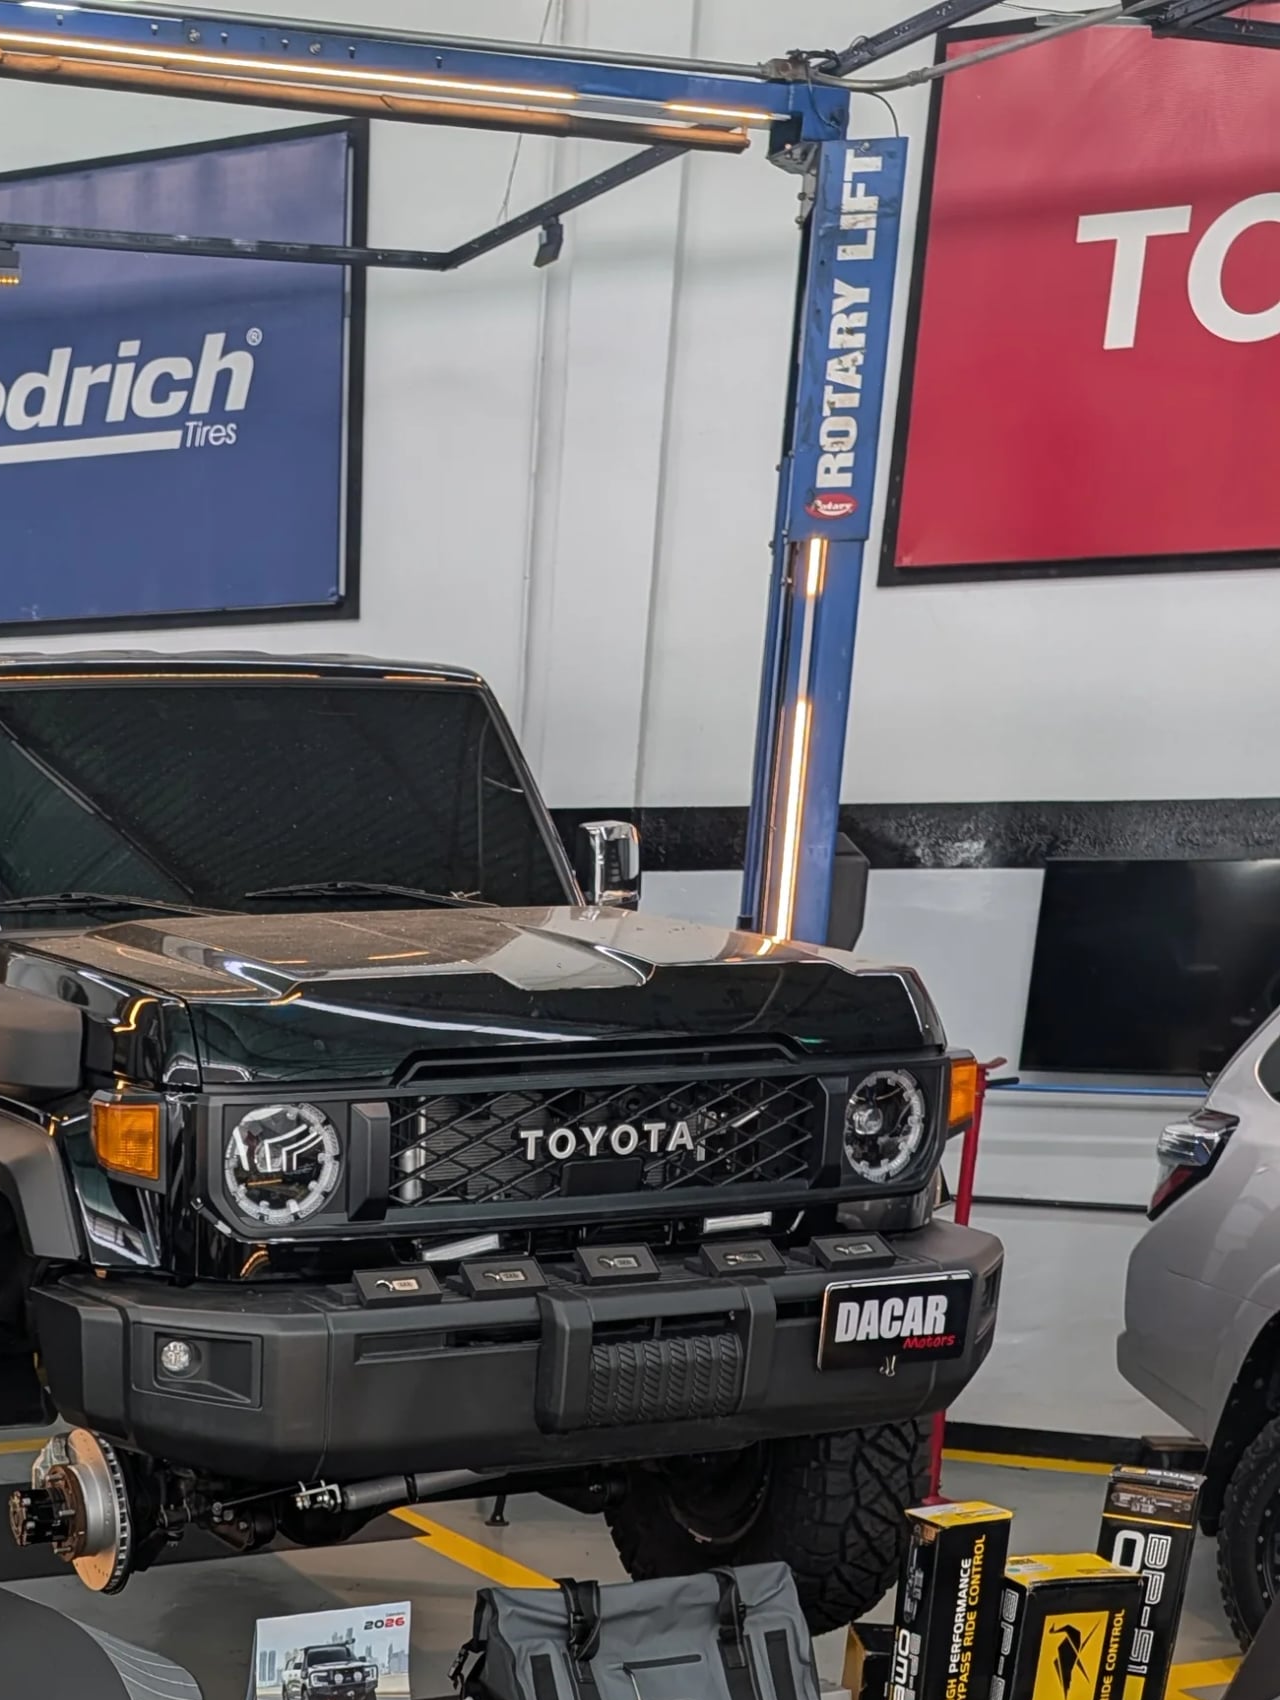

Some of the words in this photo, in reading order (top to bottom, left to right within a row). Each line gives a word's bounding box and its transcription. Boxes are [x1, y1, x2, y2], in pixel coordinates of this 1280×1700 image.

[837, 149, 883, 261] LIFT
[816, 279, 870, 488] ROTARY
[185, 420, 237, 449] Tires
[519, 1120, 695, 1162] TOYOTA
[834, 1294, 948, 1345] DACAR
[903, 1332, 956, 1350] Motors
[969, 1533, 986, 1607] CONTROL
[364, 1616, 405, 1631] 2026
[948, 1557, 972, 1674] PERFORMANCE
[963, 1611, 977, 1647] RIDE
[1128, 1533, 1172, 1675] BP-51
[1106, 1608, 1125, 1671] CONTROL
